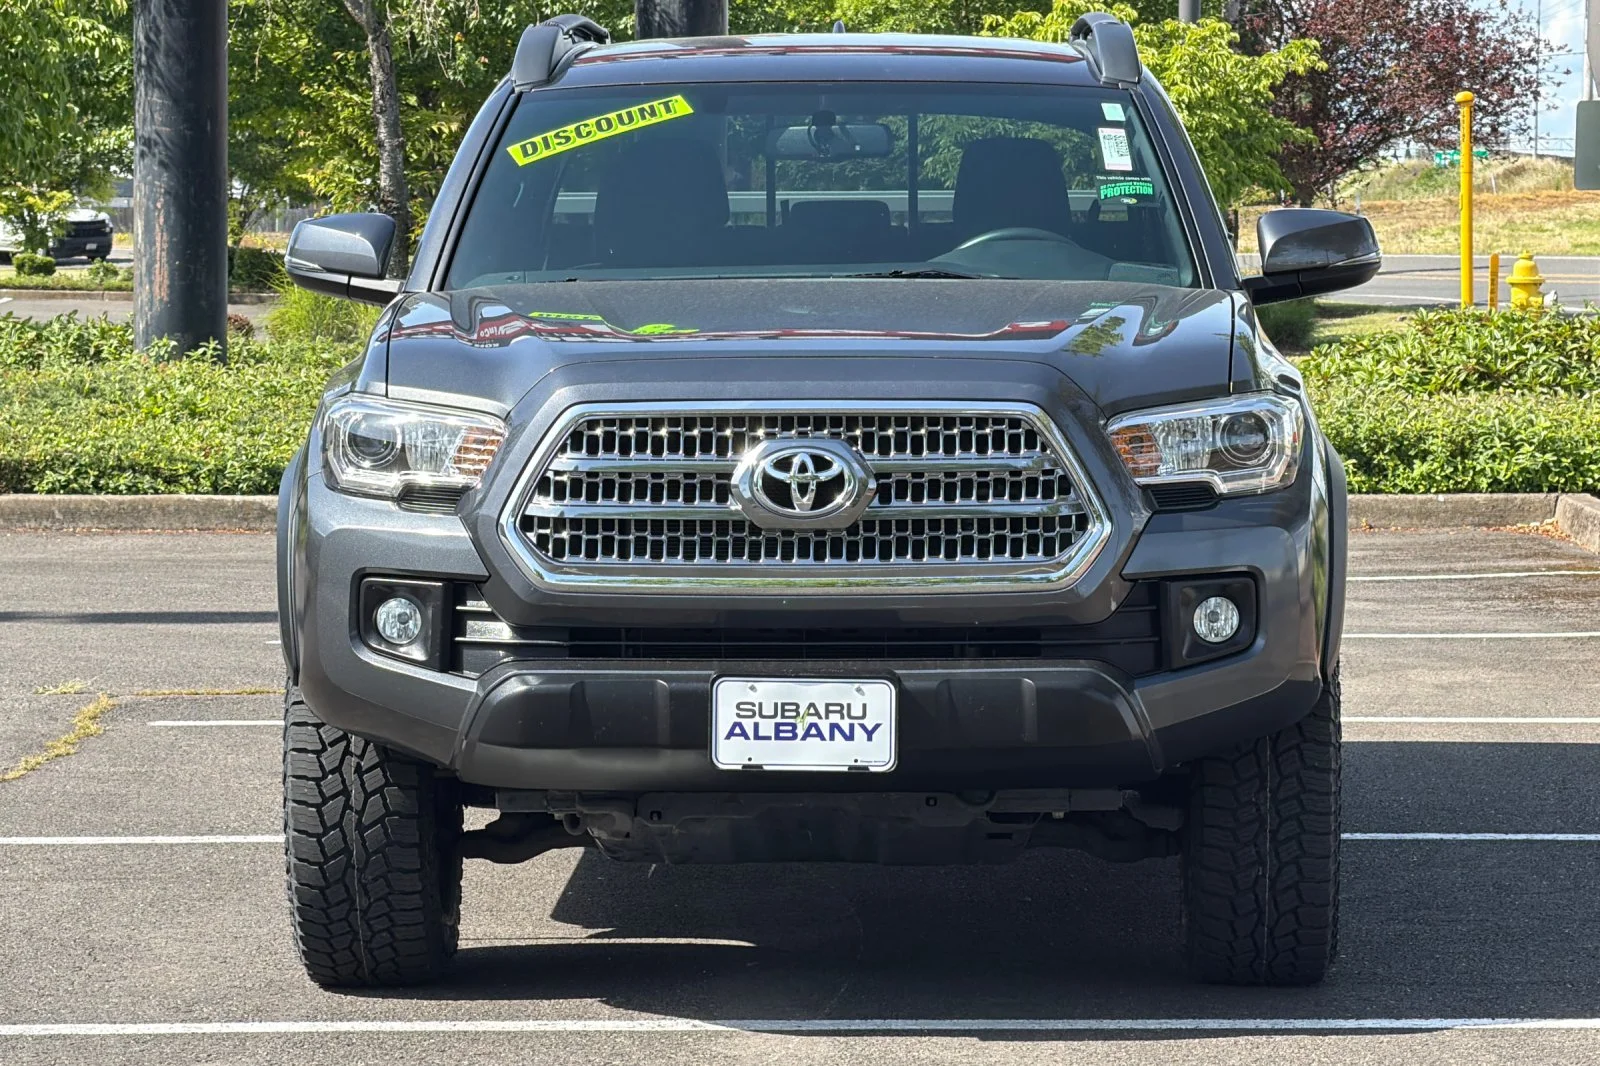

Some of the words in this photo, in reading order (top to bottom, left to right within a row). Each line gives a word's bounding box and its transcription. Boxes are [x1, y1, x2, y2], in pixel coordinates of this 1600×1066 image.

[519, 98, 678, 159] DISCOUNT
[1100, 185, 1154, 200] PROTECTION
[735, 701, 868, 721] SUBARU
[724, 721, 884, 742] ALBANY
